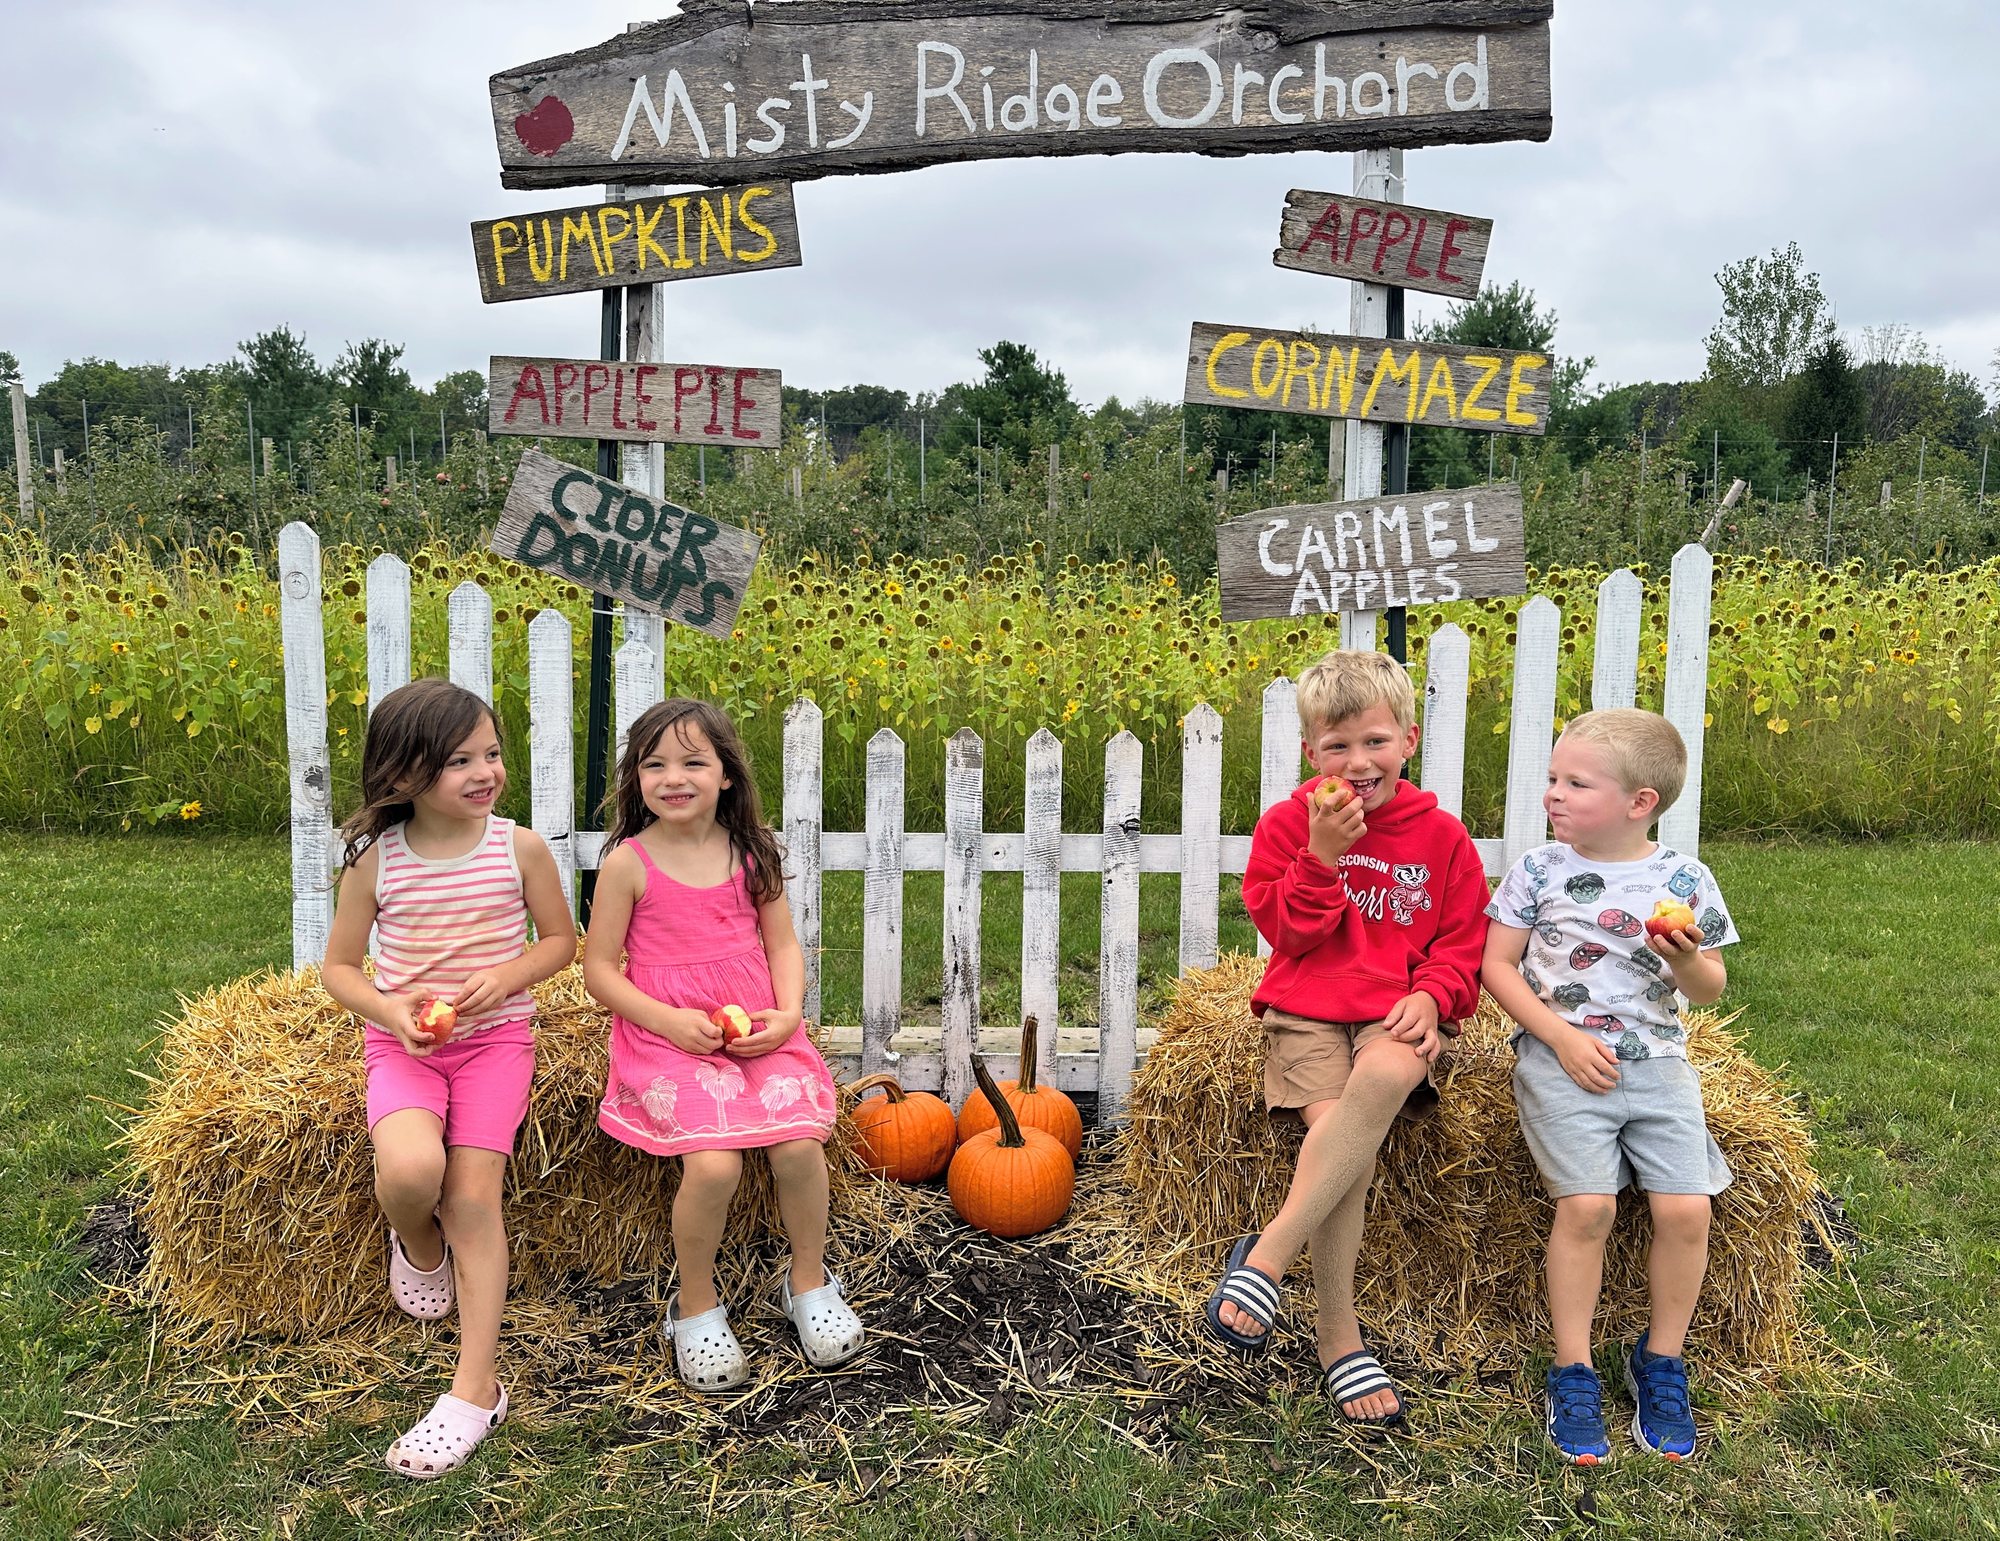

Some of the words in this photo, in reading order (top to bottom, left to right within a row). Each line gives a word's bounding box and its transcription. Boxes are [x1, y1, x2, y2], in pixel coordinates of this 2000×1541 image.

[611, 54, 873, 161] Misty
[916, 41, 1124, 136] Ridge
[1143, 35, 1489, 128] Orchard
[491, 187, 778, 286] PUMPKINS
[1299, 203, 1470, 283] APPLE
[504, 364, 659, 432] APPLE
[674, 368, 761, 439] PIE
[1206, 332, 1360, 415] CORN
[1361, 347, 1548, 426] MAZE
[516, 511, 734, 626] DONUTS
[552, 470, 719, 583] CIDER
[1258, 501, 1499, 577] CARMEL
[1290, 563, 1462, 616] APPLES
[1337, 854, 1389, 874] SCONSIN
